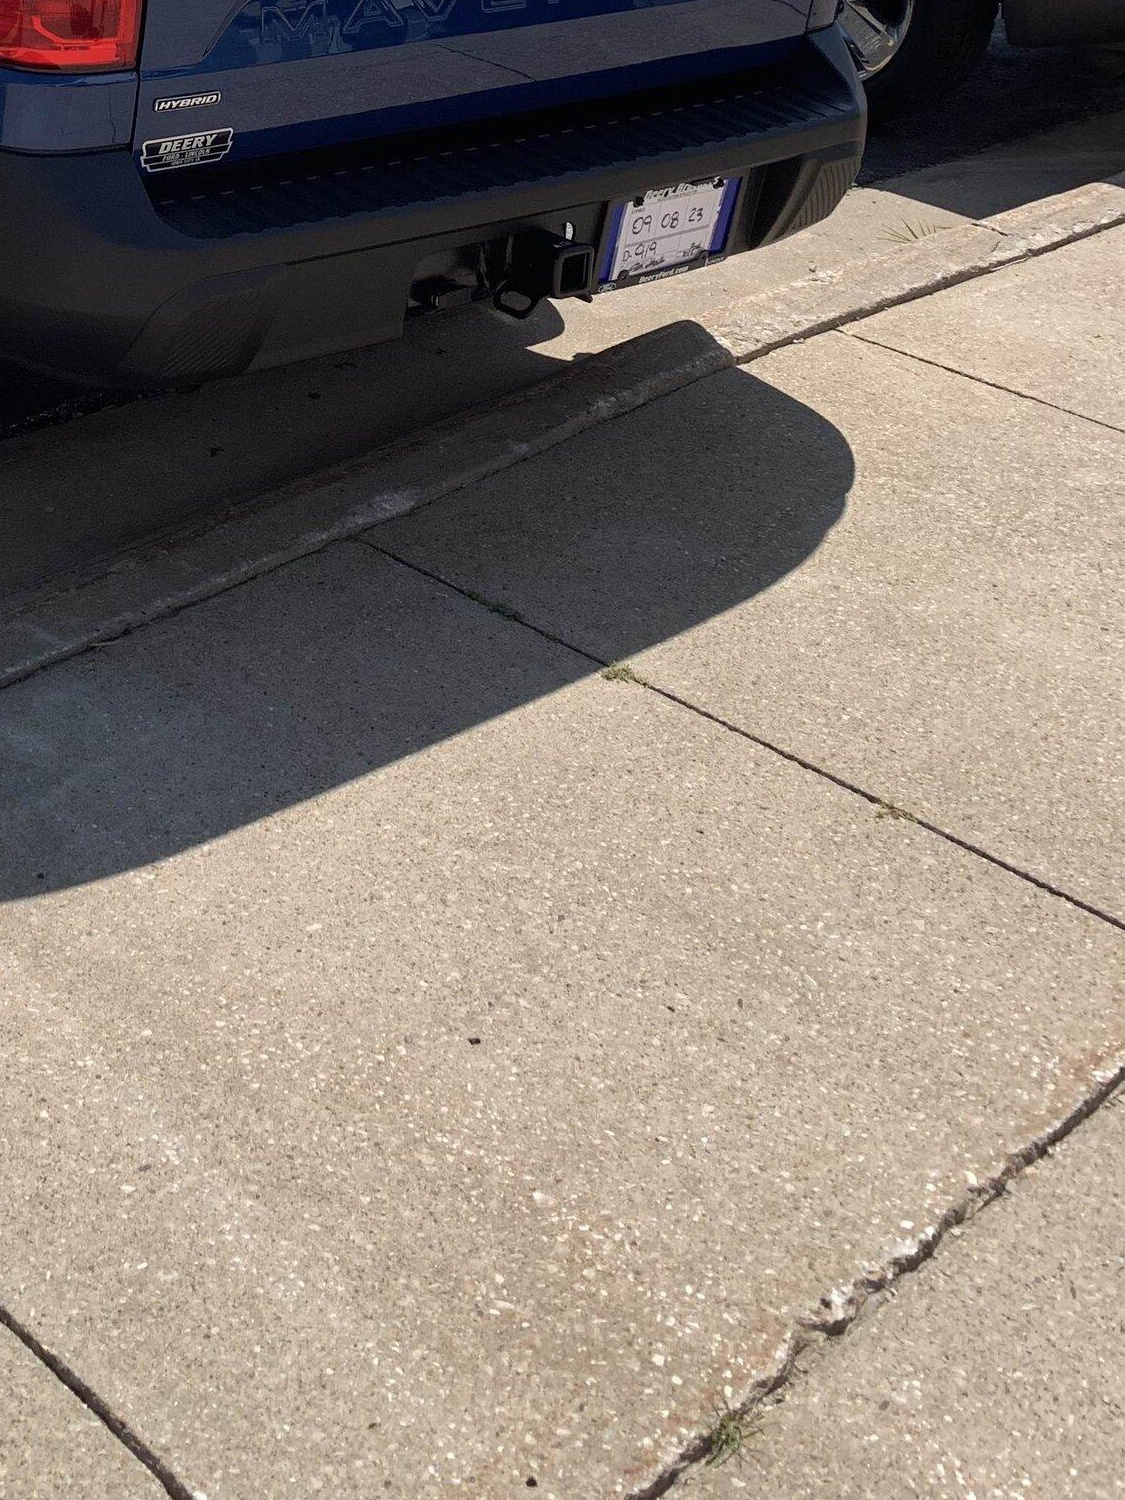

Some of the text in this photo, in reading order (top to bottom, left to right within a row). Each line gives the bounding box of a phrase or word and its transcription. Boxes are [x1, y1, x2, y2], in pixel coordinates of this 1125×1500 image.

[158, 94, 217, 110] HYBRID
[158, 134, 217, 154] DEERY
[162, 153, 180, 162] FORD
[632, 214, 653, 235] 09
[660, 210, 680, 229] 08
[688, 207, 704, 223] 23
